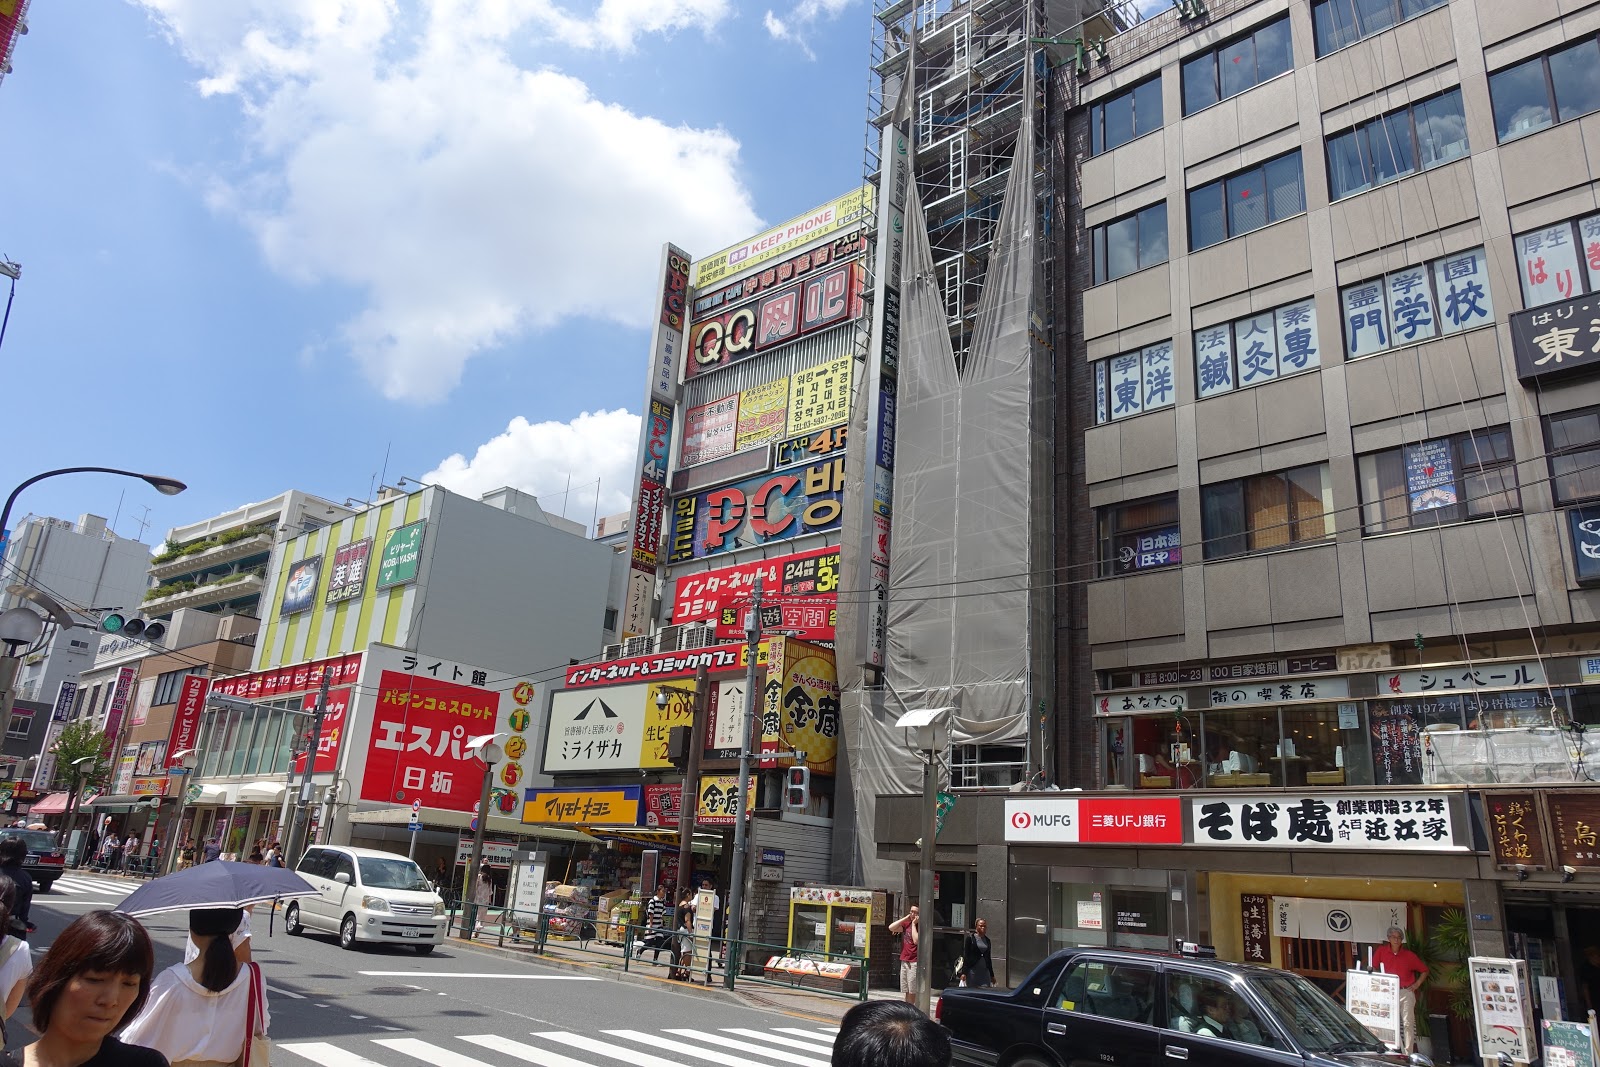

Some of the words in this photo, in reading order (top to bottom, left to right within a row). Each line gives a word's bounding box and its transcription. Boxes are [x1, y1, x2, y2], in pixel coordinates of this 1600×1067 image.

[751, 233, 784, 254] KEEP
[787, 210, 832, 239] PHONE
[669, 255, 690, 277] QQ
[745, 248, 829, 293] 中華物産店
[725, 282, 743, 301] CAFE
[695, 308, 756, 365] QQ
[759, 271, 846, 344] 网吧
[688, 399, 735, 424] イー不動産
[791, 436, 810, 451] 入口
[808, 424, 848, 454] 4F
[643, 459, 665, 481] 4F
[637, 488, 651, 549] コミックカフェ
[389, 540, 415, 555] ビリヤード
[382, 551, 418, 569] KOBAYASHI
[785, 561, 804, 580] 24
[333, 558, 364, 588] 英雄
[816, 567, 840, 592] 3F
[629, 582, 640, 633] ミライザカ
[721, 613, 736, 626] 3F
[402, 655, 488, 686] ライト館
[1232, 662, 1280, 677] 自家焙煎
[1292, 659, 1328, 671] コーヒー
[265, 675, 291, 689] カラオケ
[792, 672, 832, 692] きんくら酒場
[1160, 671, 1178, 683] 8:00
[1419, 664, 1536, 691] シュベール
[112, 678, 130, 709] 化粧品
[184, 678, 202, 717] カラオケ
[1122, 694, 1184, 710] あなたの
[761, 678, 782, 736] 金の蔵
[784, 685, 841, 738] 金の蔵
[726, 694, 736, 744] ミライザカ
[562, 738, 623, 760] ミライザカ
[544, 796, 612, 822] マツモトキヨシ
[1336, 798, 1446, 816] 創業明治32年
[1033, 814, 1071, 827] MUFG
[1092, 814, 1167, 828] 三菱UFJ銀行
[1365, 816, 1449, 842] 近江家
[1493, 813, 1514, 859] とりそば
[1482, 1034, 1523, 1047] シュベール
[1100, 1053, 1115, 1062] 1924
